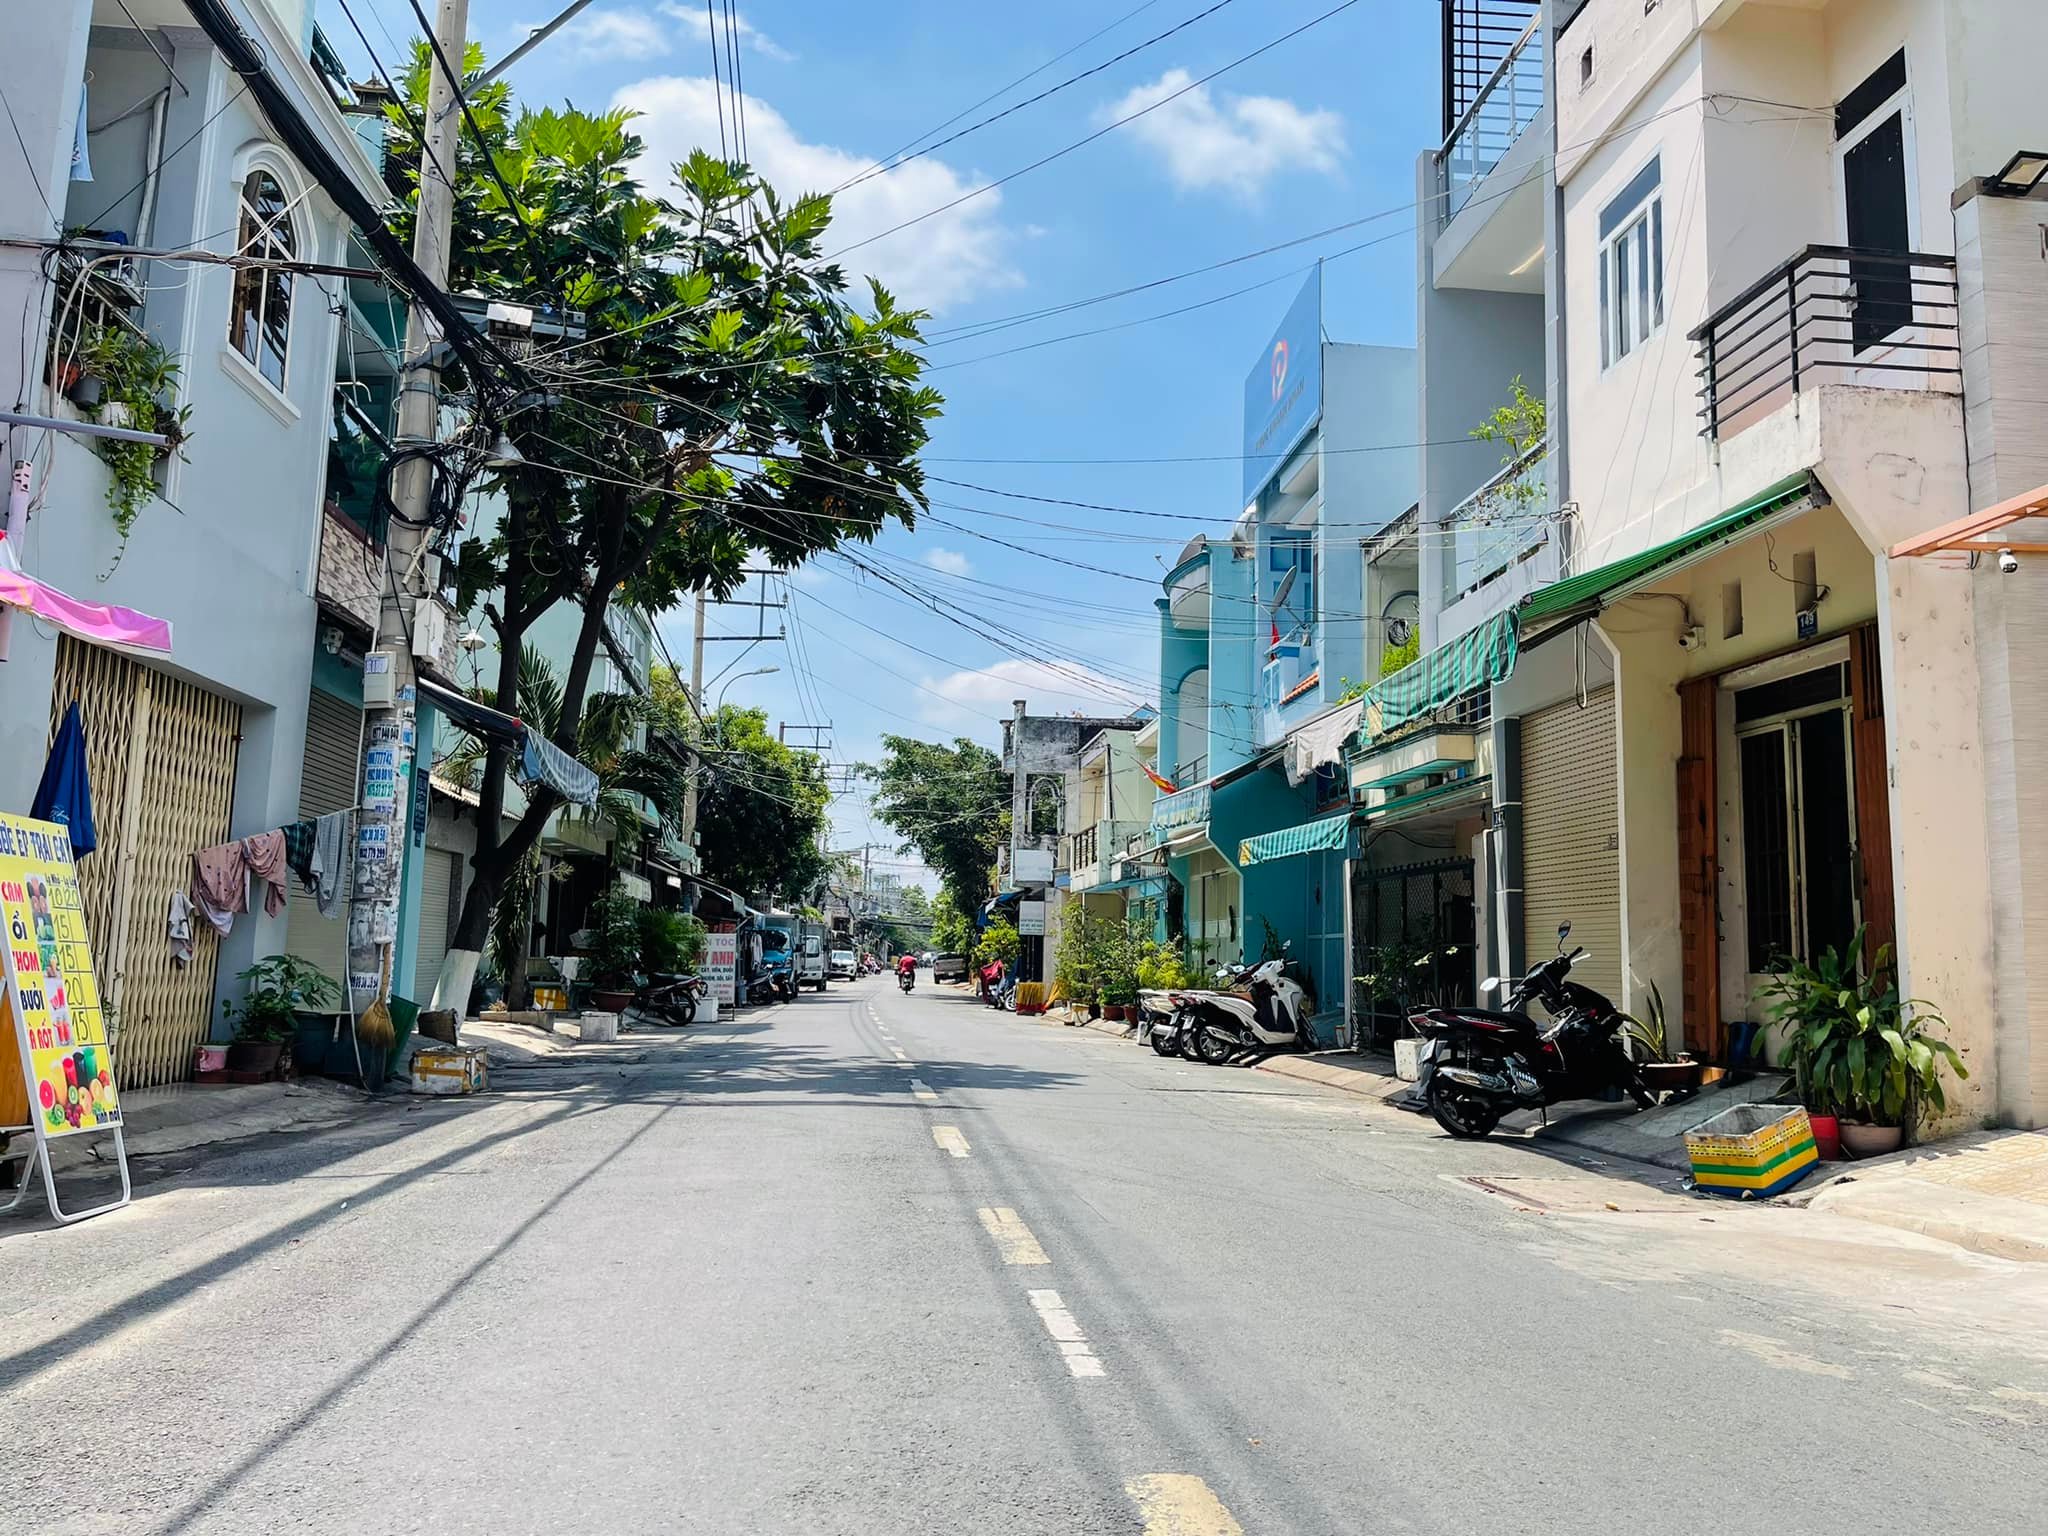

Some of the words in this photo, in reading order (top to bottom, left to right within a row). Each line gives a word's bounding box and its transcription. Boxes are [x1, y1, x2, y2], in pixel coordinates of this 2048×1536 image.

[12, 910, 28, 940] ỔI
[54, 914, 70, 939] 15
[72, 1011, 89, 1041] 15
